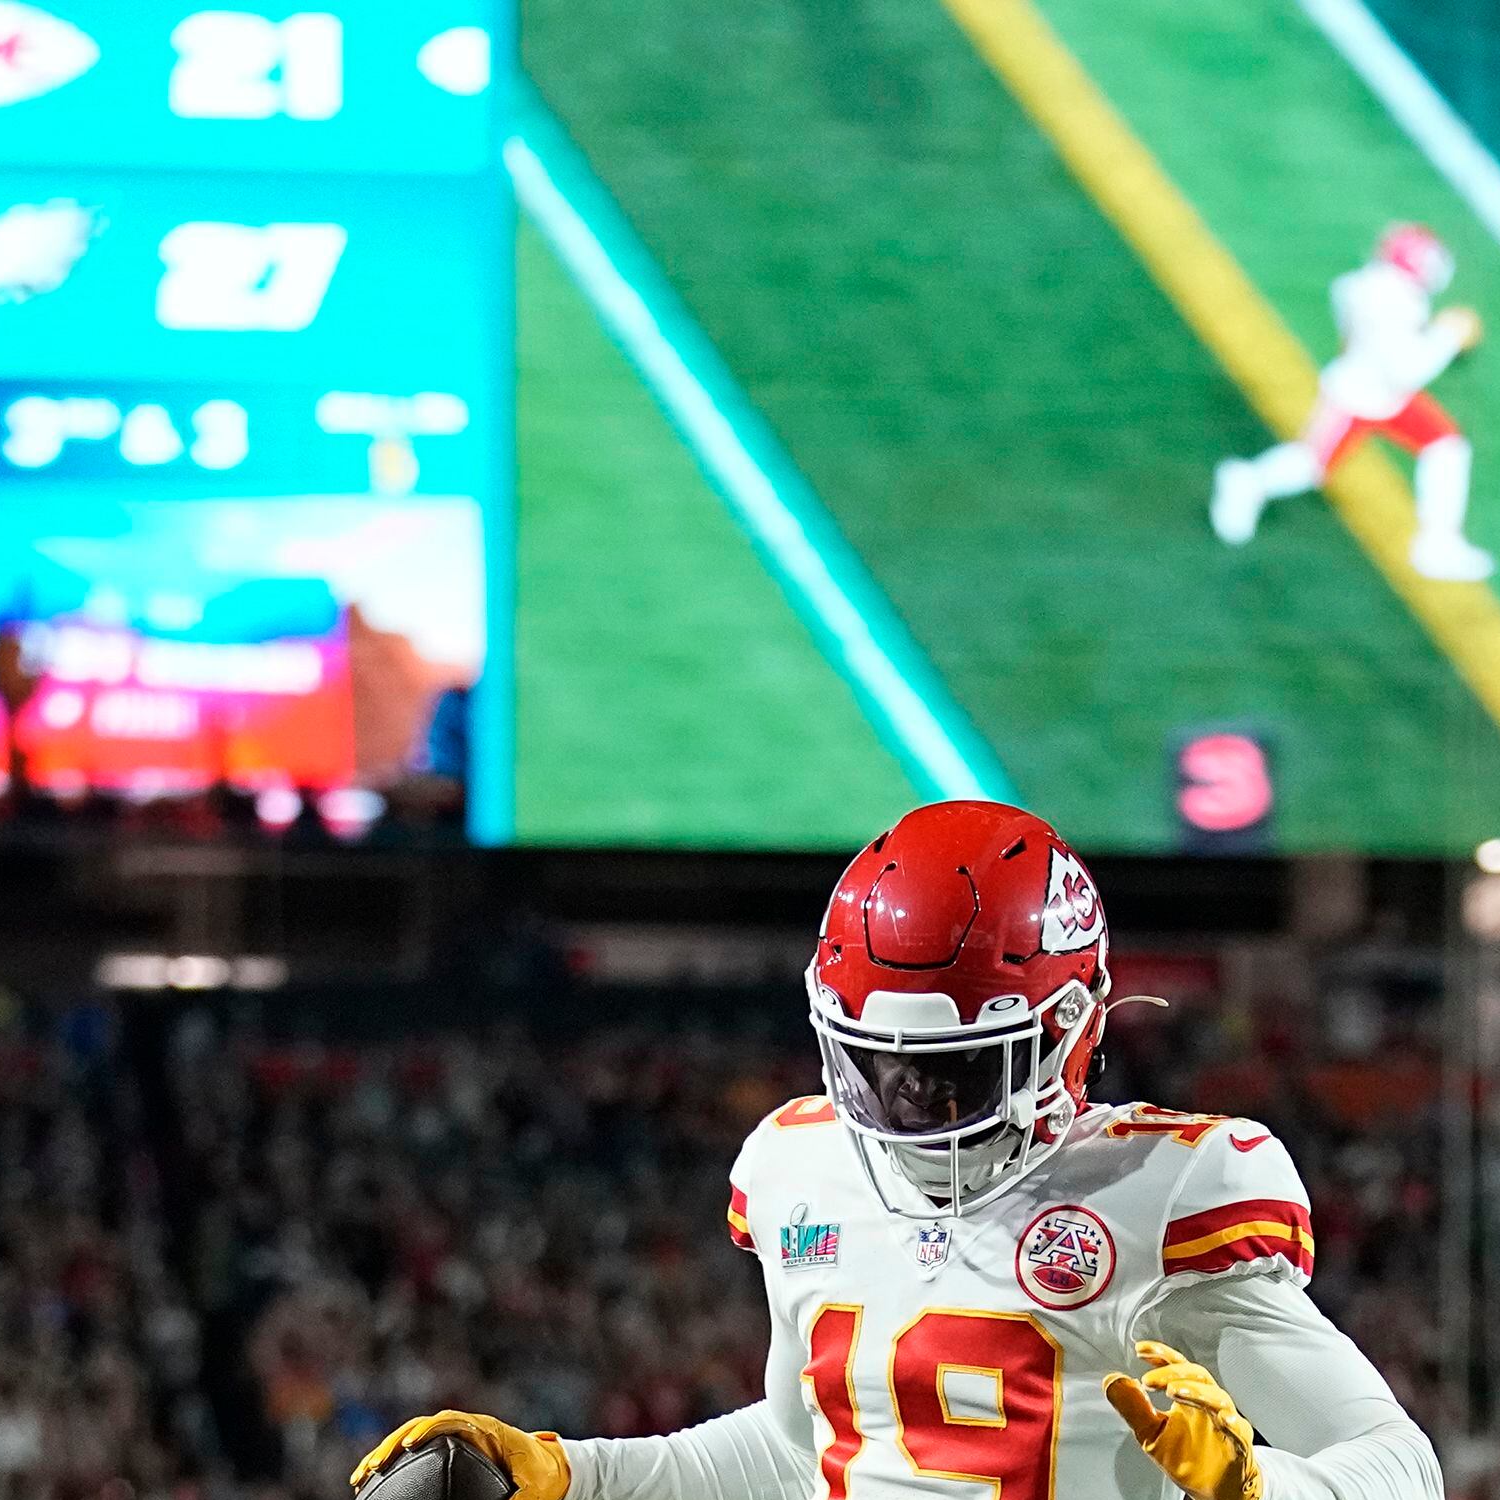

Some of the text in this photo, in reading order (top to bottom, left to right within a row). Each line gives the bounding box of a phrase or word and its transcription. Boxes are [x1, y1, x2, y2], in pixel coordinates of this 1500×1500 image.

[168, 10, 345, 121] 21
[1177, 732, 1272, 832] 3
[808, 1256, 830, 1264] BOWL
[919, 1243, 943, 1262] NFL
